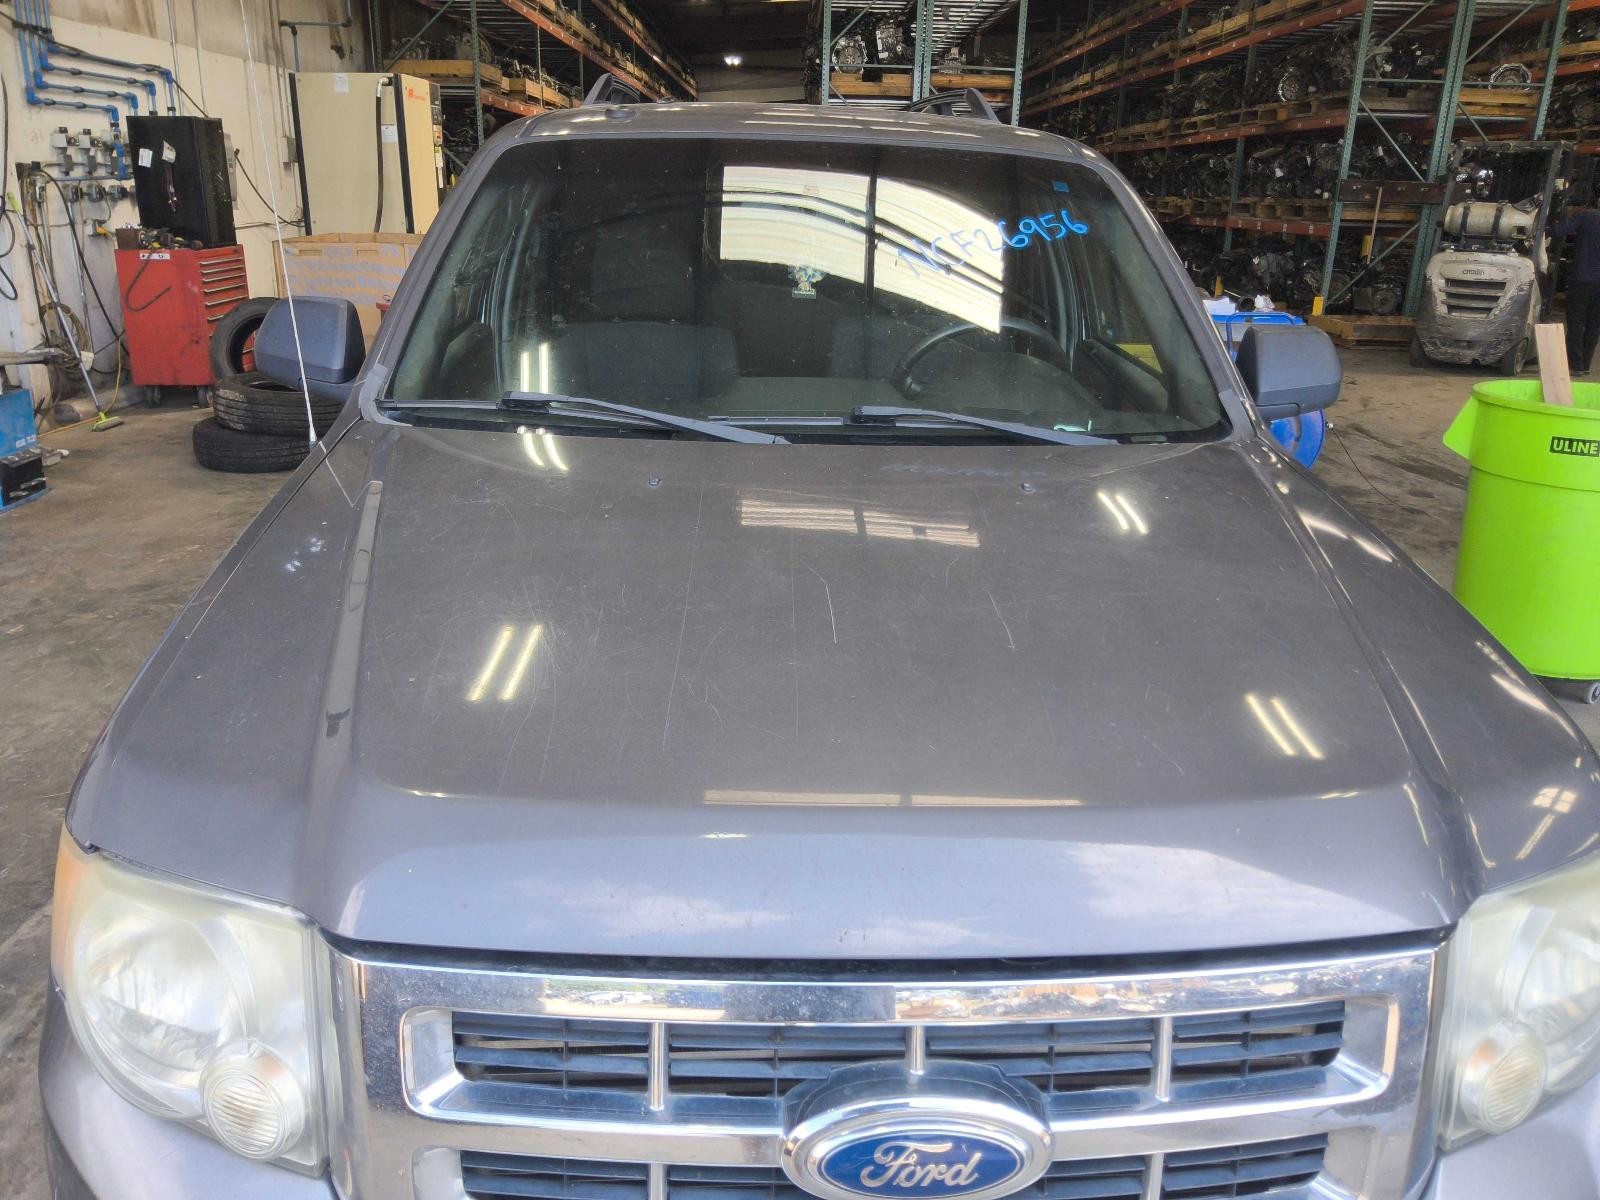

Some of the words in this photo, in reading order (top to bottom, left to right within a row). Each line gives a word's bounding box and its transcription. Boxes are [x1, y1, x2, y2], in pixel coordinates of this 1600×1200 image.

[897, 210, 1089, 277] NCF26956
[1552, 439, 1599, 455] ULINE
[859, 1140, 983, 1188] Ford
